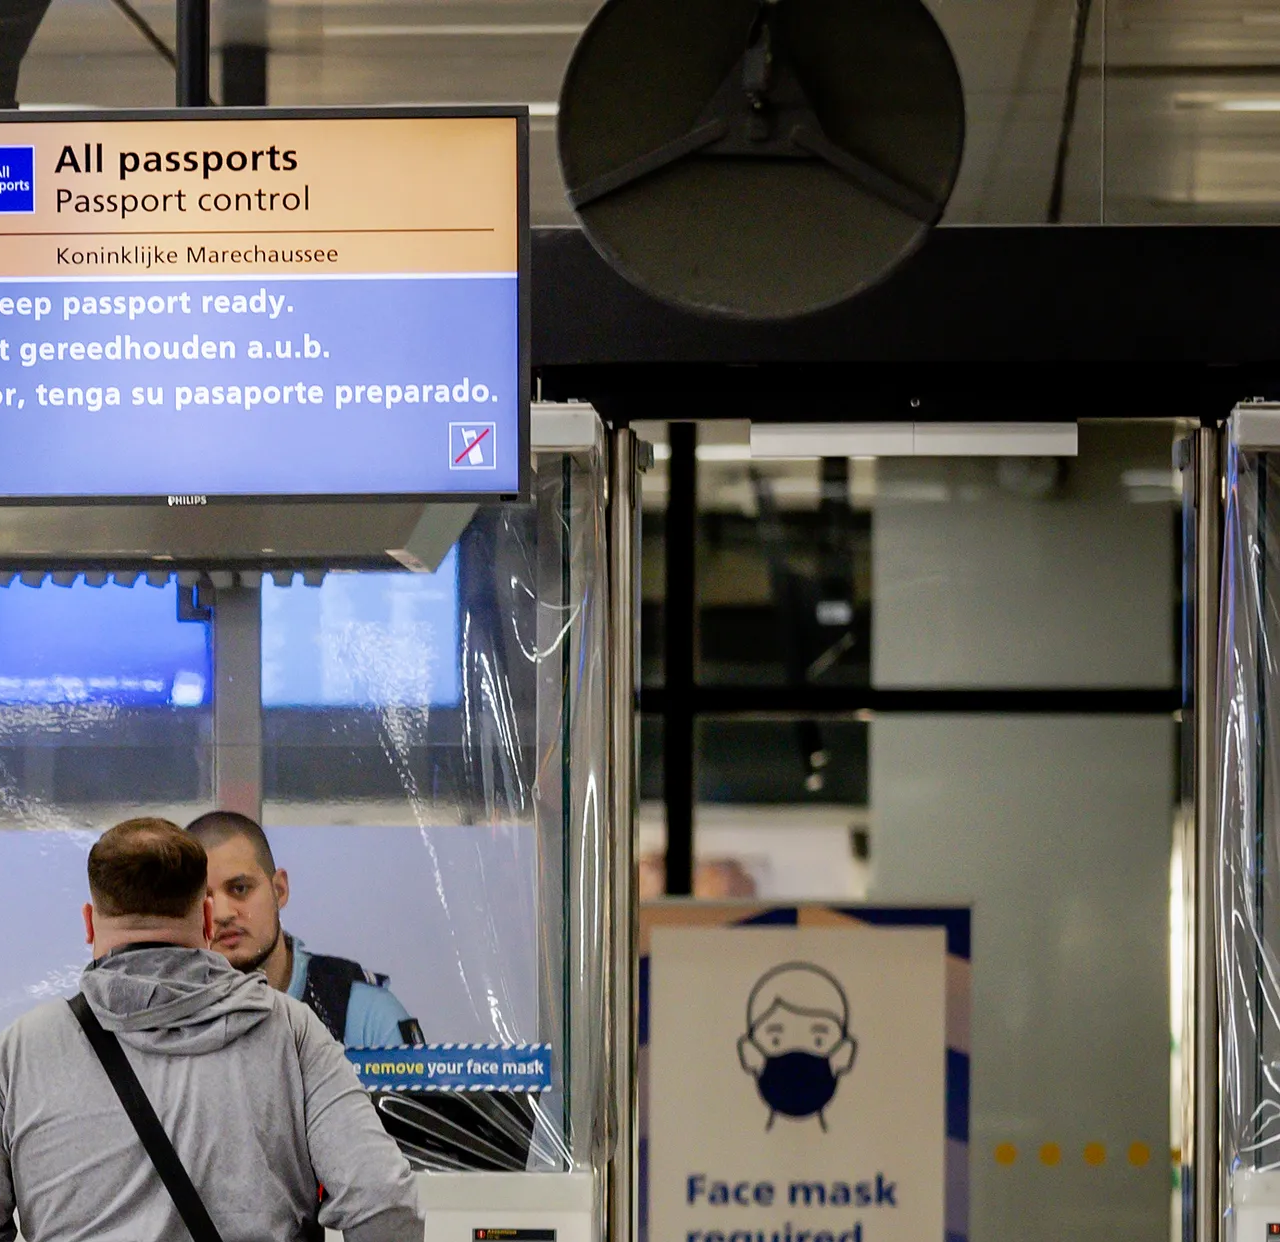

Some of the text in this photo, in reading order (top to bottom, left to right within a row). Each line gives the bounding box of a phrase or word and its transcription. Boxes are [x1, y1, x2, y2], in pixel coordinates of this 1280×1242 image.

[55, 143, 297, 180] All passports
[57, 185, 308, 218] Passport control
[58, 245, 338, 268] Koninklijke Marechaussee
[64, 292, 191, 320] passport
[203, 288, 293, 319] ready.
[20, 334, 235, 364] gereedhouden
[248, 334, 329, 358] a.u.b.
[36, 384, 120, 411] tenga
[132, 387, 163, 405] su
[176, 382, 323, 410] pasaporte
[336, 378, 497, 409] preparado.
[168, 496, 207, 505] PHILIPS
[365, 1061, 424, 1074] remove
[428, 1061, 463, 1078] your
[467, 1059, 498, 1074] face
[502, 1059, 544, 1074] mask
[685, 1173, 898, 1209] Face mask
